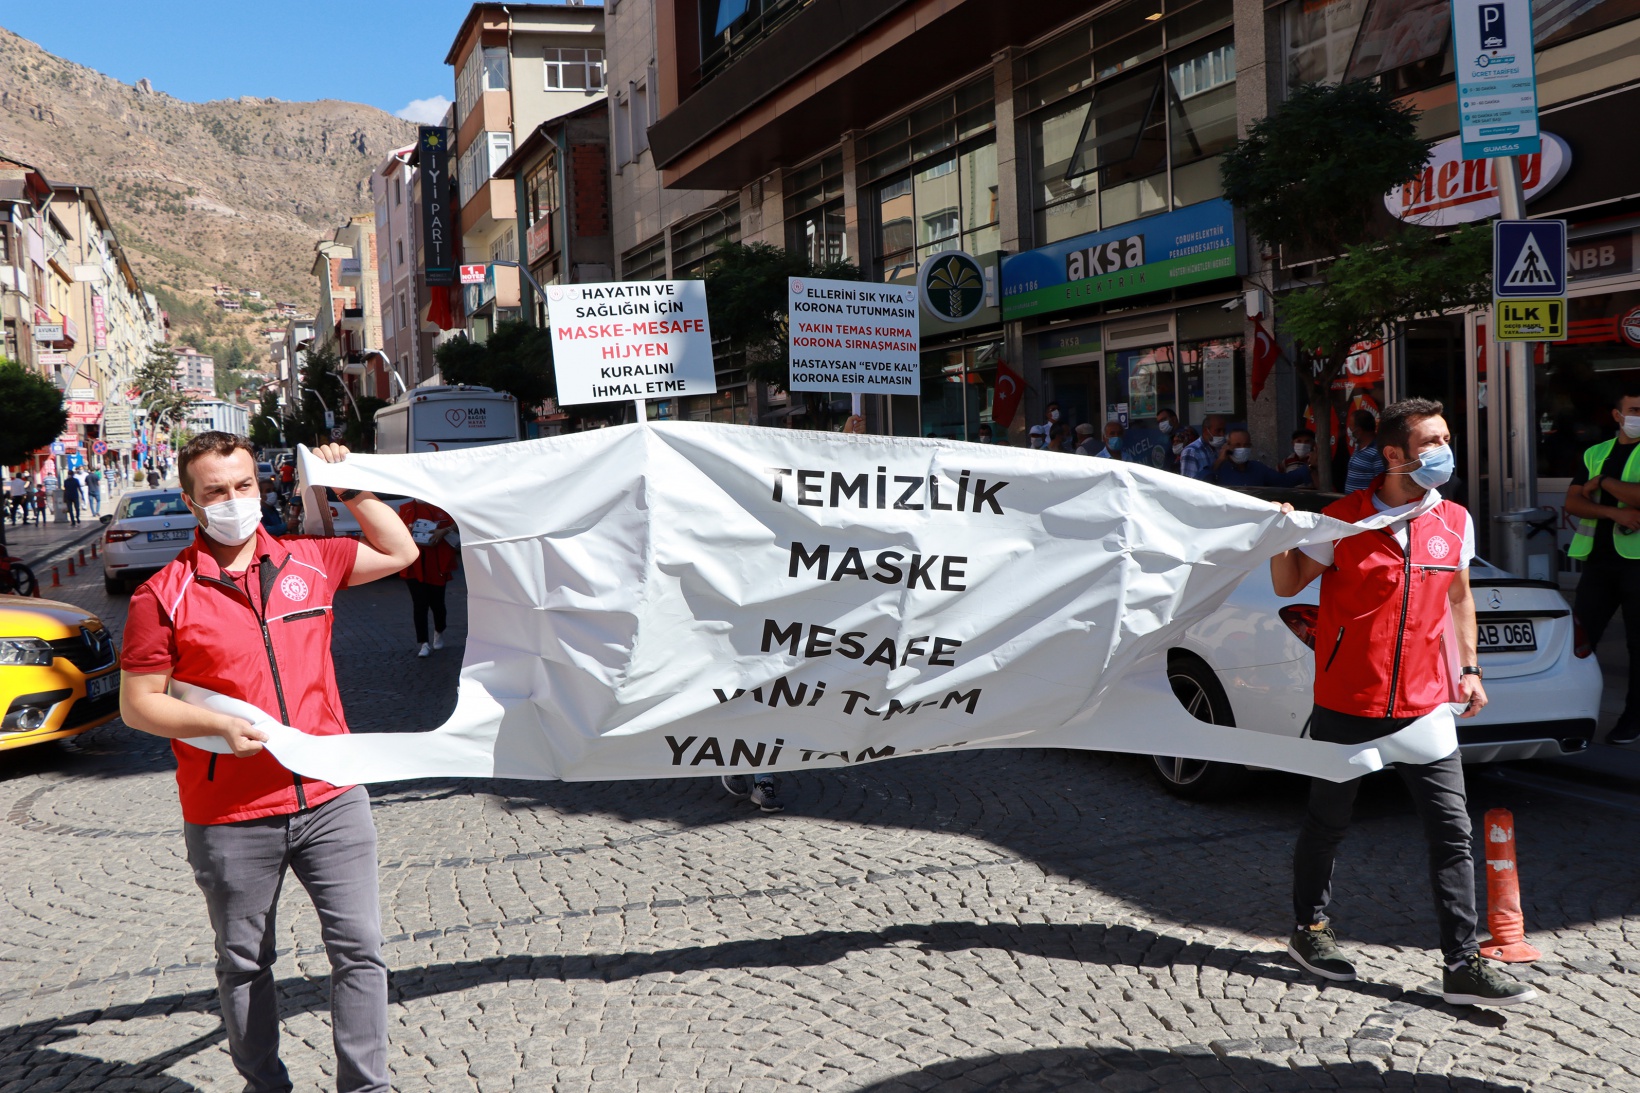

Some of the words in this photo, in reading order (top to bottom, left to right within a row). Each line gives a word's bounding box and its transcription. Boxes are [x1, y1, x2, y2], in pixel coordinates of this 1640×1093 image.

[1484, 7, 1499, 32] P
[1494, 68, 1520, 76] TARİFESİ
[429, 155, 440, 198] İYİ
[431, 203, 442, 266] PARTİ
[1176, 232, 1194, 246] ÇORUH
[1196, 224, 1224, 240] ELEKTRİK
[1068, 235, 1144, 281] aksa
[1169, 245, 1202, 258] PERAKENDE
[582, 285, 650, 300] HAYATIN
[655, 284, 674, 296] VE
[1004, 285, 1017, 296] 444
[1019, 284, 1022, 293] 9
[1026, 280, 1038, 291] 186
[1066, 272, 1146, 298] ELEKTRİK
[807, 288, 856, 300] ELLERİNİ
[859, 292, 876, 302] SIK
[879, 293, 904, 304] YIKA
[576, 302, 650, 318] SAĞLIĞIN
[654, 300, 684, 315] İÇİN
[794, 302, 843, 314] KORONA
[846, 305, 914, 318] TUTUNMASIN
[1504, 305, 1540, 320] İLK
[558, 319, 704, 340] MASKE-MESAFE
[799, 323, 832, 334] YAKIN
[836, 324, 872, 335] TEMAS
[876, 327, 912, 338] KURMA
[602, 342, 668, 360] HİJYEN
[794, 337, 842, 348] KORONA
[845, 340, 916, 352] SIRNAŞMASIN
[1060, 336, 1080, 348] aksa
[600, 362, 674, 378] KURALINI
[792, 359, 856, 370] HASTAYSAN
[792, 374, 840, 383] KORONA
[842, 373, 864, 384] ESİR
[868, 375, 912, 385] ALMASIN
[592, 384, 642, 398] İHMAL
[646, 380, 686, 393] ETME
[764, 466, 1010, 515] TEMİZLİK
[788, 542, 968, 592] MASKE
[1504, 624, 1532, 644] 066
[760, 618, 962, 670] MESAFE
[664, 736, 785, 767] YANİ
